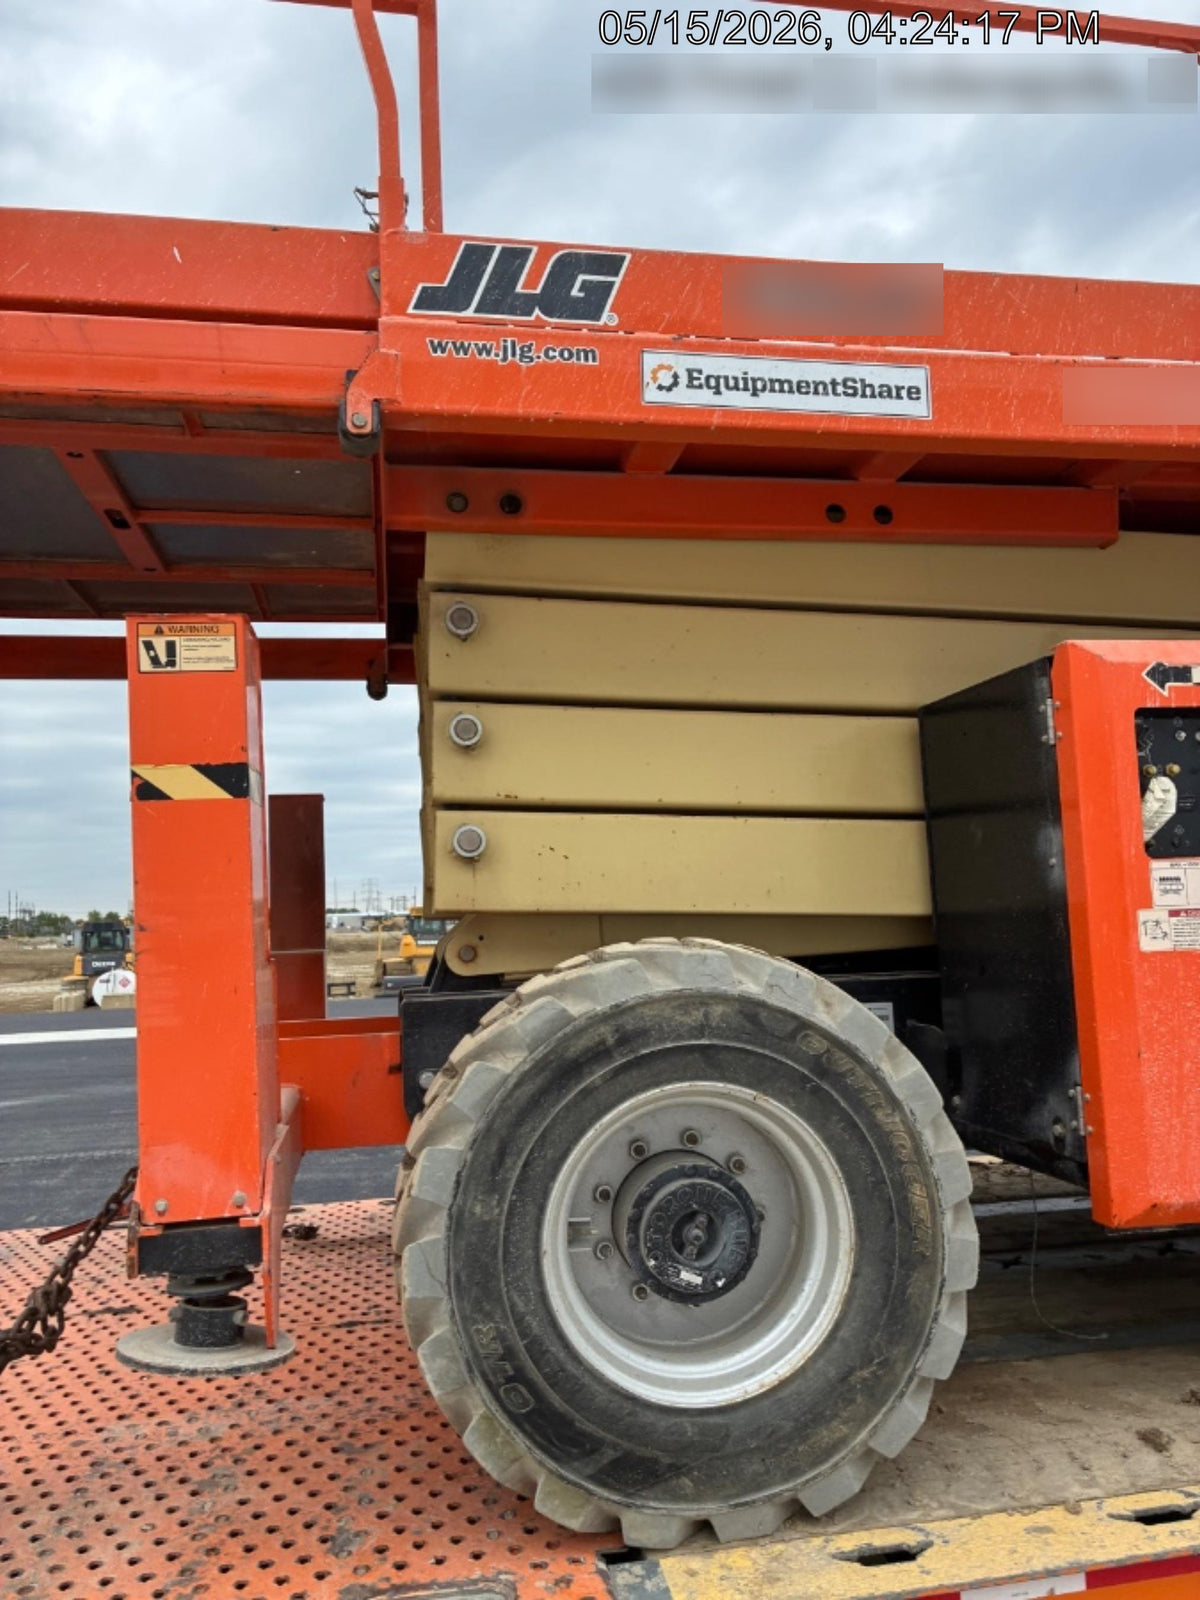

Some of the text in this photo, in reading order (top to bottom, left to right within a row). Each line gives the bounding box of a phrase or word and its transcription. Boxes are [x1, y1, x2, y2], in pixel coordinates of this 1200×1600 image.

[427, 338, 599, 365] www.jlg.com
[685, 368, 923, 402] EquipmentShare
[168, 625, 220, 634] WARNING
